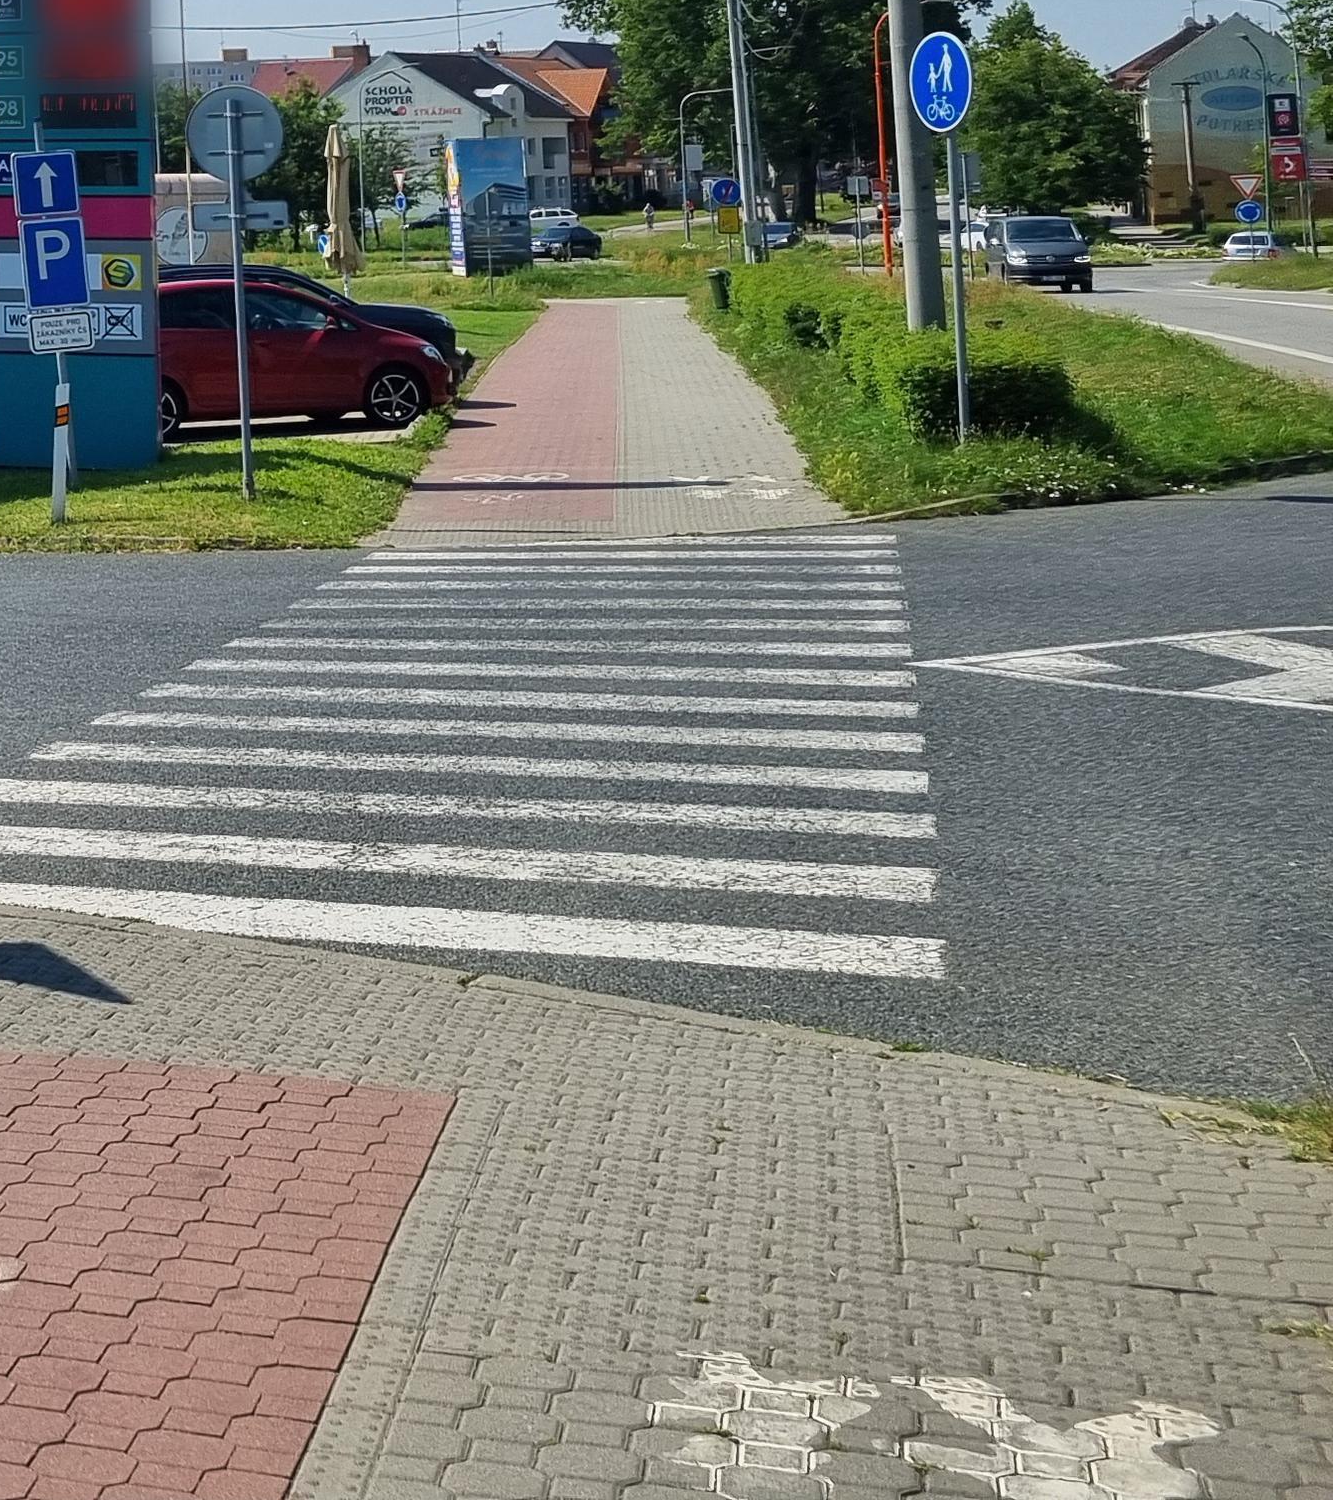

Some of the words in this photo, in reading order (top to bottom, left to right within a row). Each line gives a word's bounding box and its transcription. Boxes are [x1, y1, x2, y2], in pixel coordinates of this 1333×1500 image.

[365, 86, 413, 96] SCHOLA
[365, 95, 413, 105] PROPTER
[364, 106, 392, 116] VITAM
[35, 229, 71, 281] P
[9, 314, 28, 327] WC
